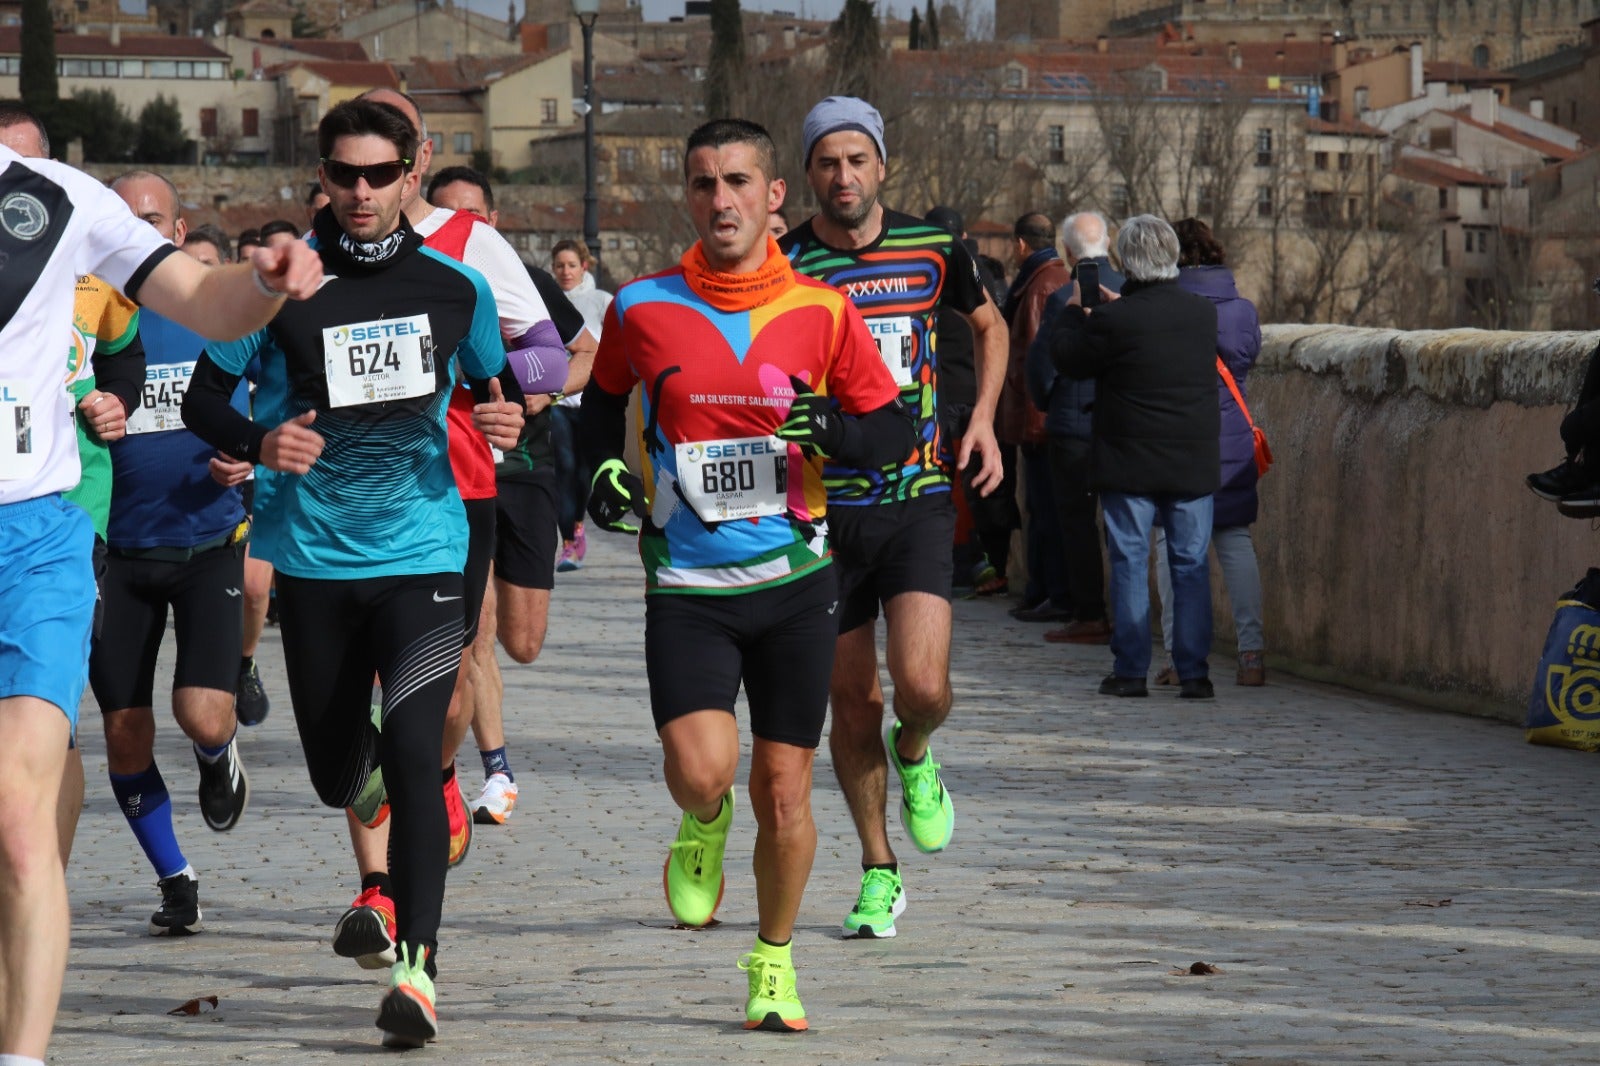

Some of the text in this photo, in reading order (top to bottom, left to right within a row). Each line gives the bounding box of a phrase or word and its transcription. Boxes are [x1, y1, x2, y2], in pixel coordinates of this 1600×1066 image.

[847, 277, 908, 298] XXXVIII
[351, 322, 420, 341] SETEL
[348, 341, 401, 376] 624
[363, 373, 390, 382] VICTOR
[142, 381, 185, 409] 645
[689, 394, 793, 408] SAN SILVESTRE SALMANTIN
[706, 441, 776, 459] SETEL
[702, 460, 755, 493] 680
[717, 491, 744, 499] GASPAR
